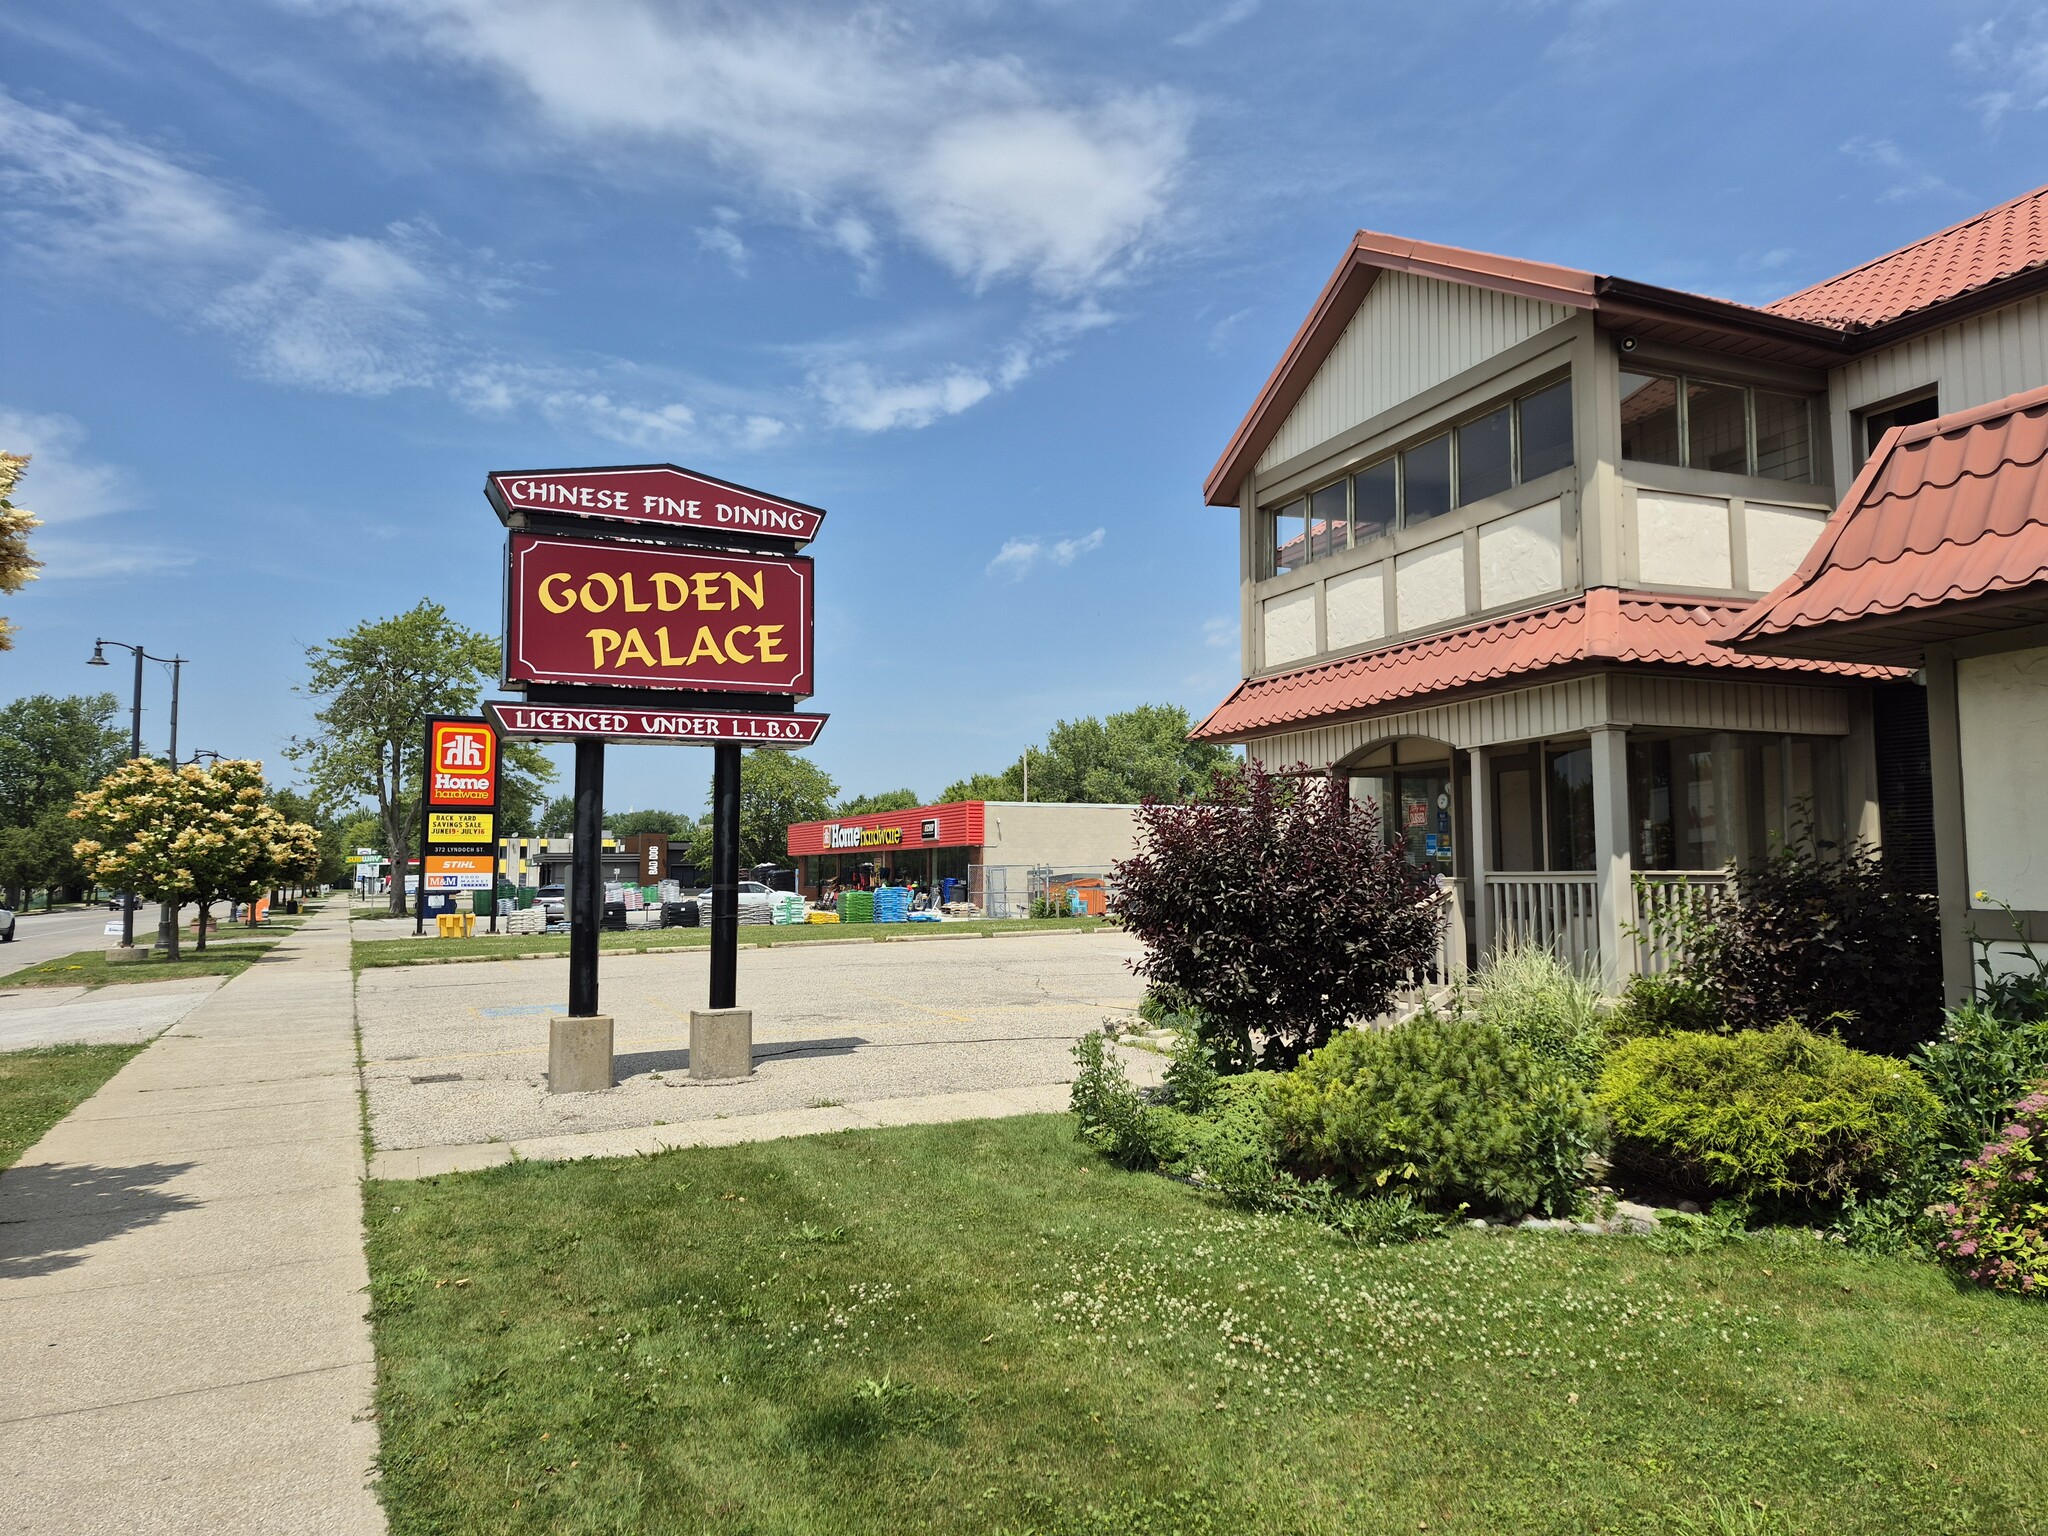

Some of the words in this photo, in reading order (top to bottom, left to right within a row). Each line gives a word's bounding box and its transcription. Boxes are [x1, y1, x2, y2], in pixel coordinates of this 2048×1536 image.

[511, 480, 629, 511] CHINESE
[643, 495, 702, 519] FINE
[716, 503, 805, 531] DINING
[538, 570, 765, 614] GOLDEN
[585, 624, 789, 670] PALACE
[516, 710, 629, 732] LICENCED
[641, 716, 721, 735] UNDER
[732, 719, 804, 738] L.L.B.O.
[435, 774, 489, 790] Home
[435, 788, 489, 799] hardware
[831, 824, 860, 848] Home
[860, 825, 901, 846] hardware
[346, 855, 382, 863] SUBWAY
[442, 861, 476, 869] STIHL
[648, 861, 658, 875] BAD
[429, 877, 457, 886] M&M
